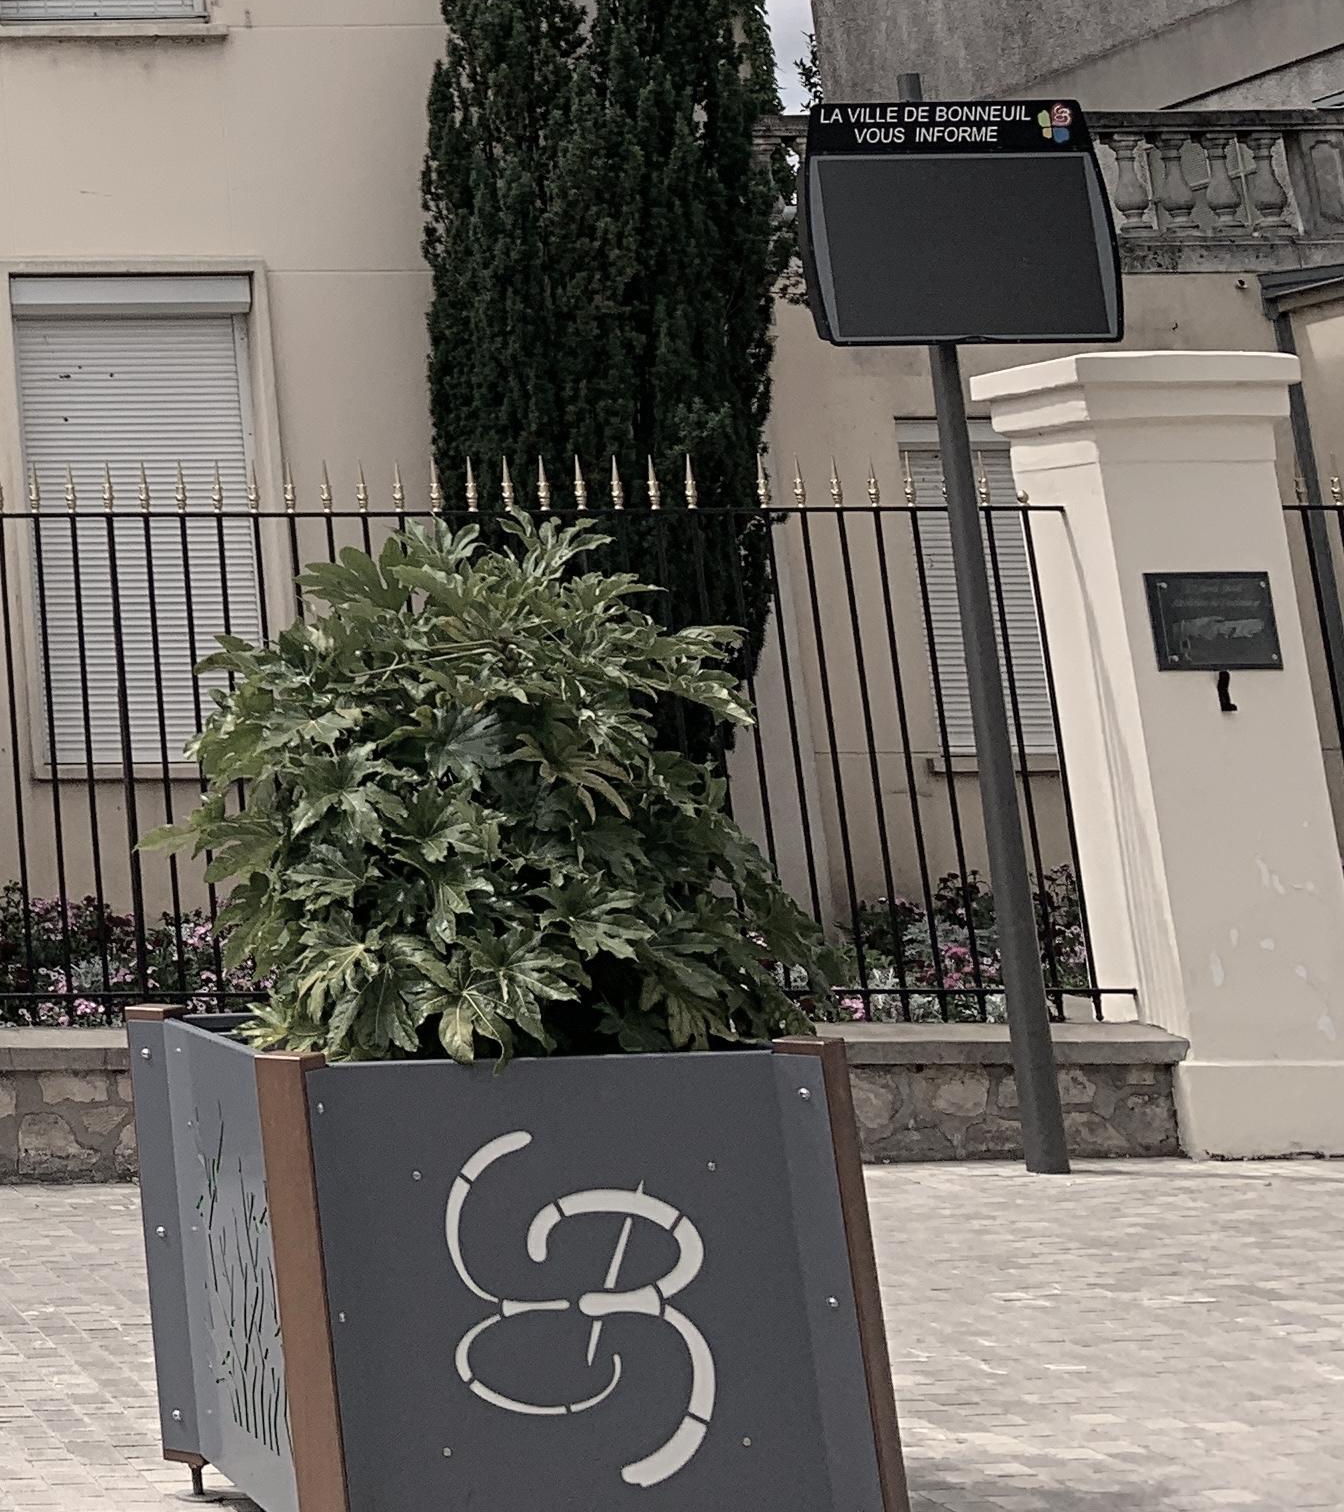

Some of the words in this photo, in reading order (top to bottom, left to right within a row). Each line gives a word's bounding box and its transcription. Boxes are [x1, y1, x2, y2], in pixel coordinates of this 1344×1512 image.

[820, 108, 843, 124] LA
[848, 107, 898, 123] VILLE
[904, 106, 929, 122] DE
[935, 105, 1031, 122] BONNEUIL
[855, 127, 905, 144] VOUS
[915, 126, 998, 143] INFORME
